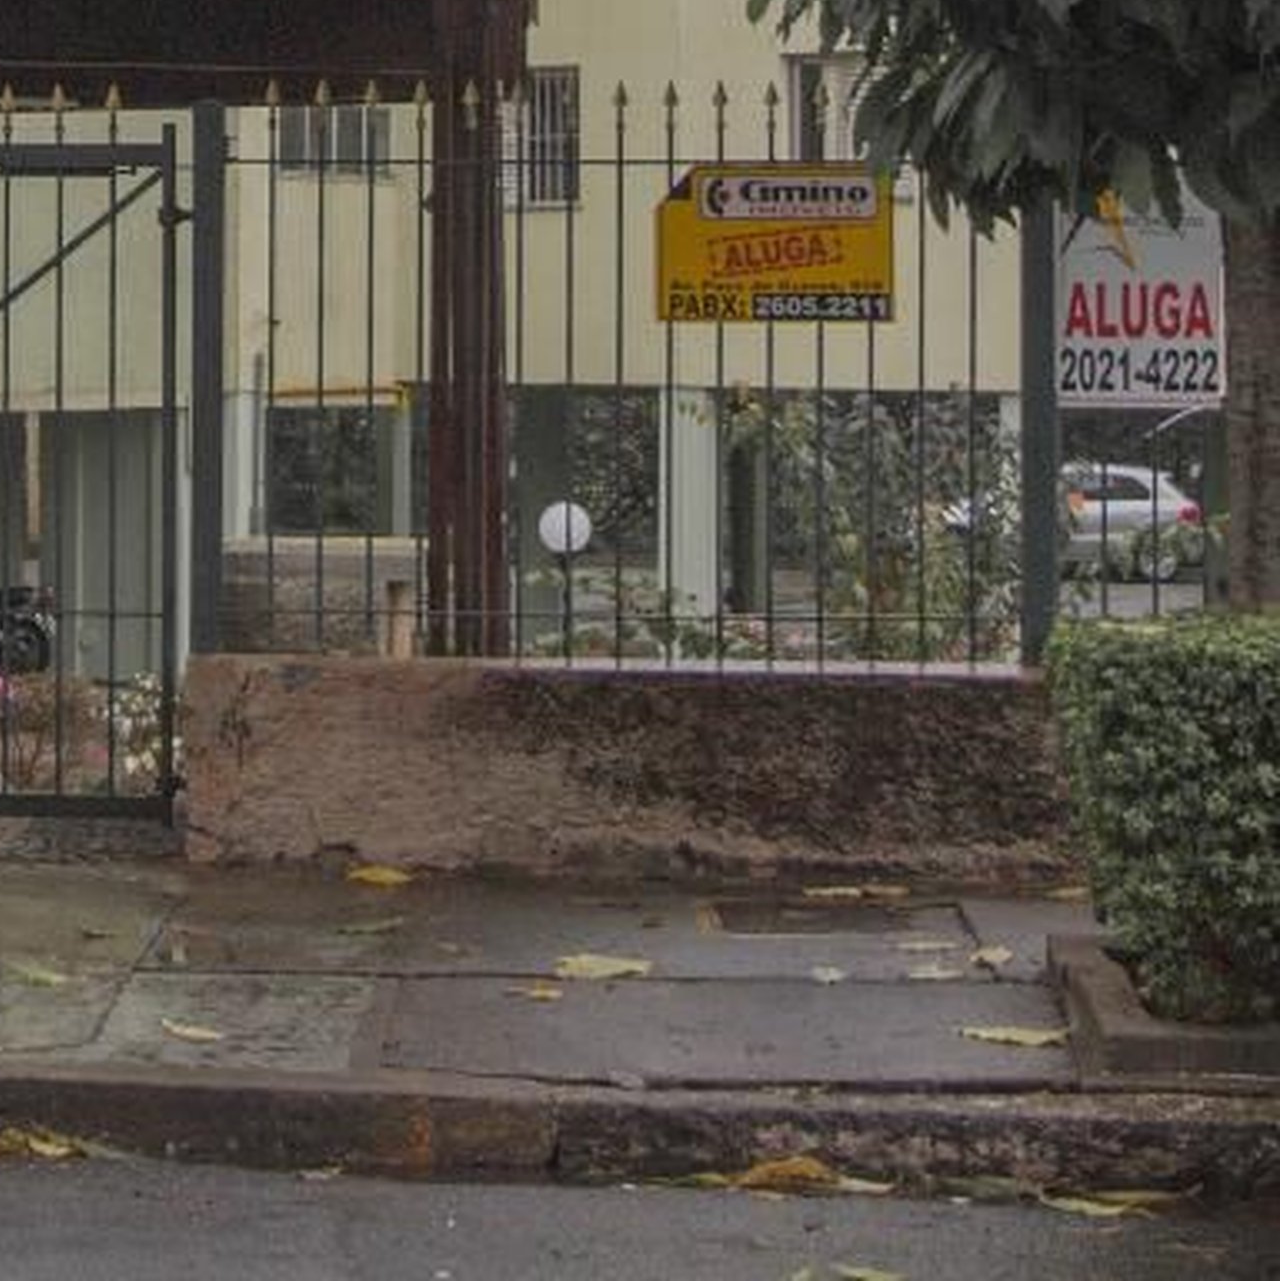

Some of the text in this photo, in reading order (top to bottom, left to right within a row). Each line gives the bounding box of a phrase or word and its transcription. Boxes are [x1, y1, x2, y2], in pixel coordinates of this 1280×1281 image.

[724, 234, 829, 270] ALUGA
[1066, 281, 1213, 339] ALUGA
[1060, 346, 1219, 392] 2021-4222
